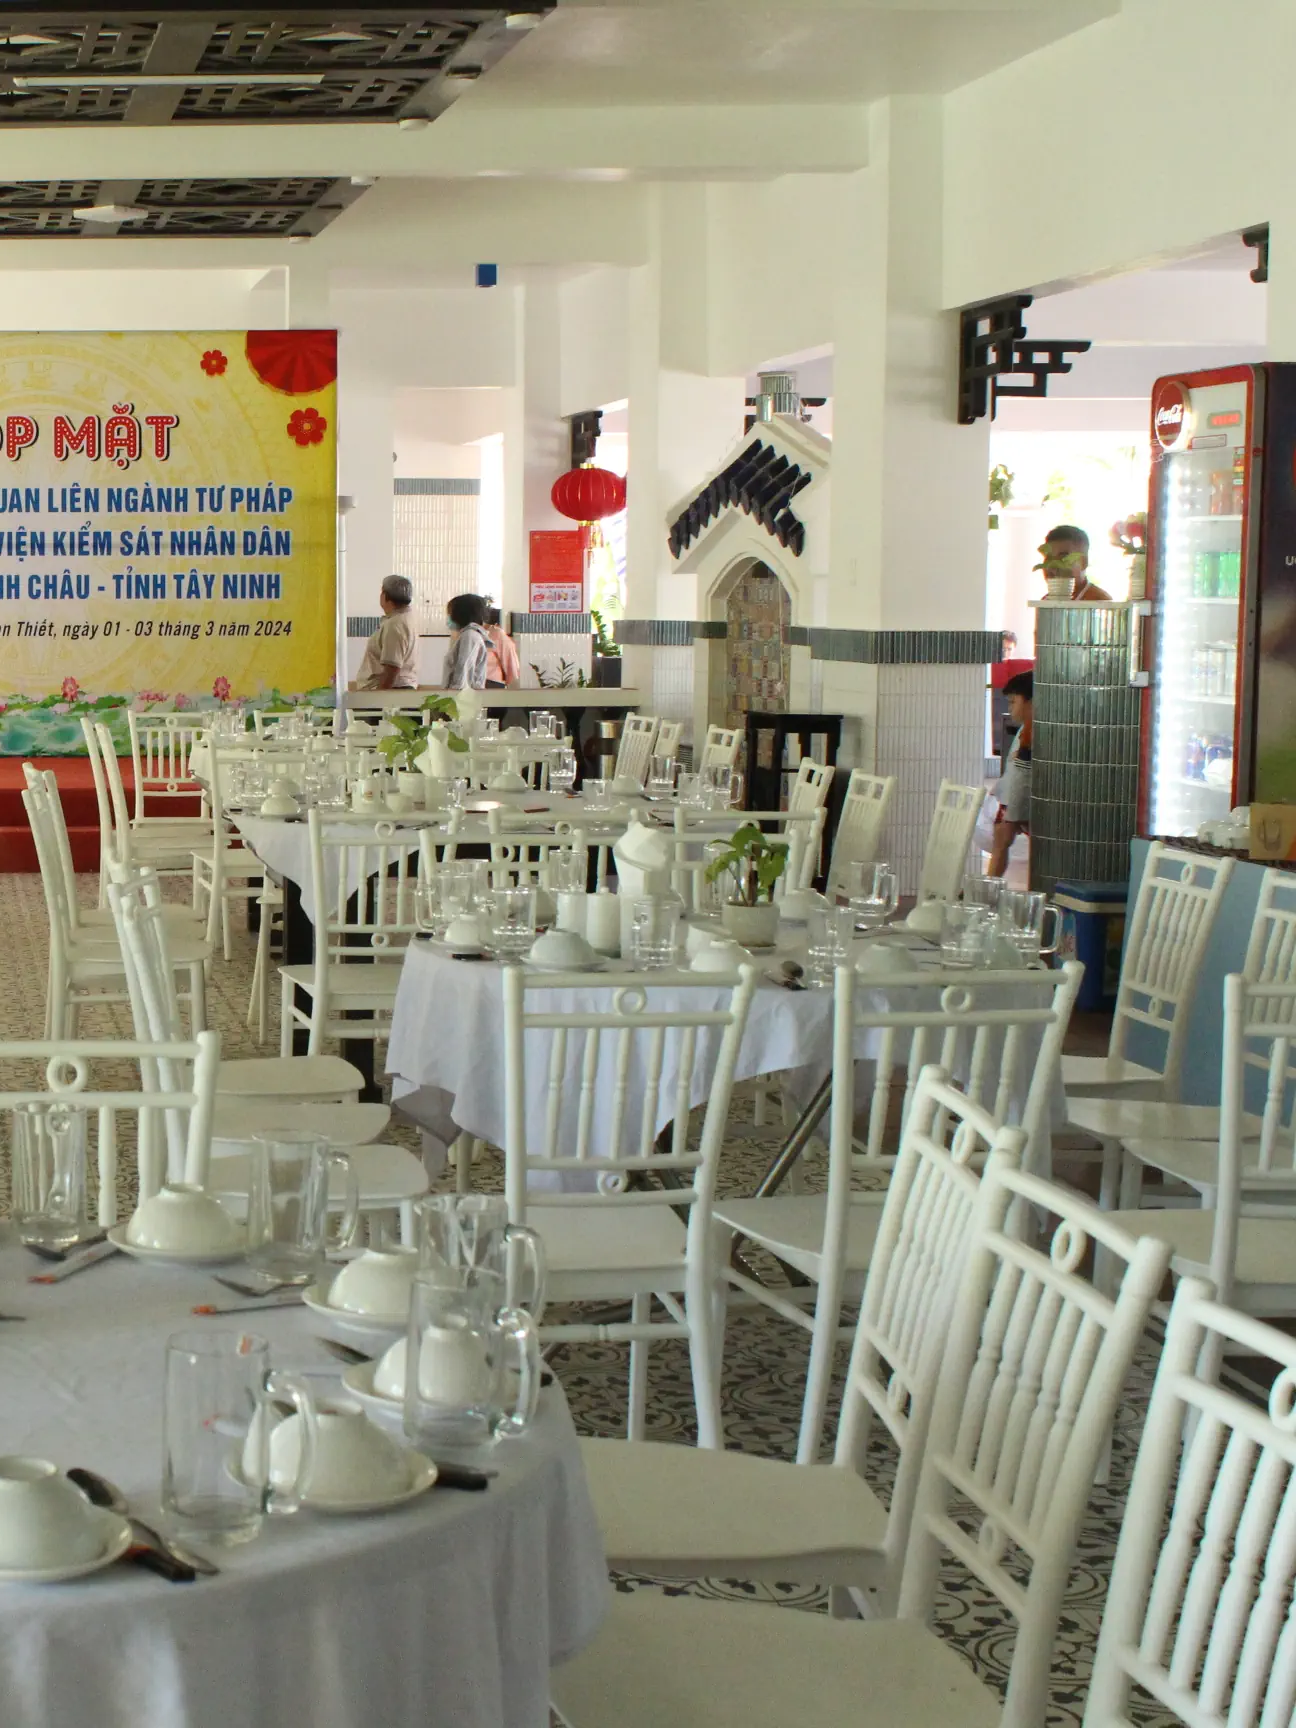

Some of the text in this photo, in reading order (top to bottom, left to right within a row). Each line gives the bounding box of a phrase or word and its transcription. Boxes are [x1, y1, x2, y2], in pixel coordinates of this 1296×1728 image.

[54, 402, 179, 470] MẶT
[47, 482, 101, 513] LIÊN
[107, 481, 189, 513] NGÀNH
[195, 486, 225, 512] TƯ
[230, 482, 293, 512] PHÁP
[51, 521, 113, 556] KIỂM
[119, 525, 164, 556] SÁT
[170, 525, 237, 556] NHÂN
[243, 525, 291, 556] DÂN
[27, 568, 91, 600] CHÂU
[112, 565, 167, 599] TỈNH
[174, 568, 216, 599] TÂY
[223, 573, 281, 599] NINH
[17, 617, 58, 639] Thiết,
[62, 620, 99, 642] ngày
[103, 620, 122, 637] 01
[134, 620, 154, 637] 03
[158, 618, 201, 642] tháng
[204, 620, 215, 637] 3
[218, 620, 250, 637] năm
[254, 620, 292, 637] 2024
